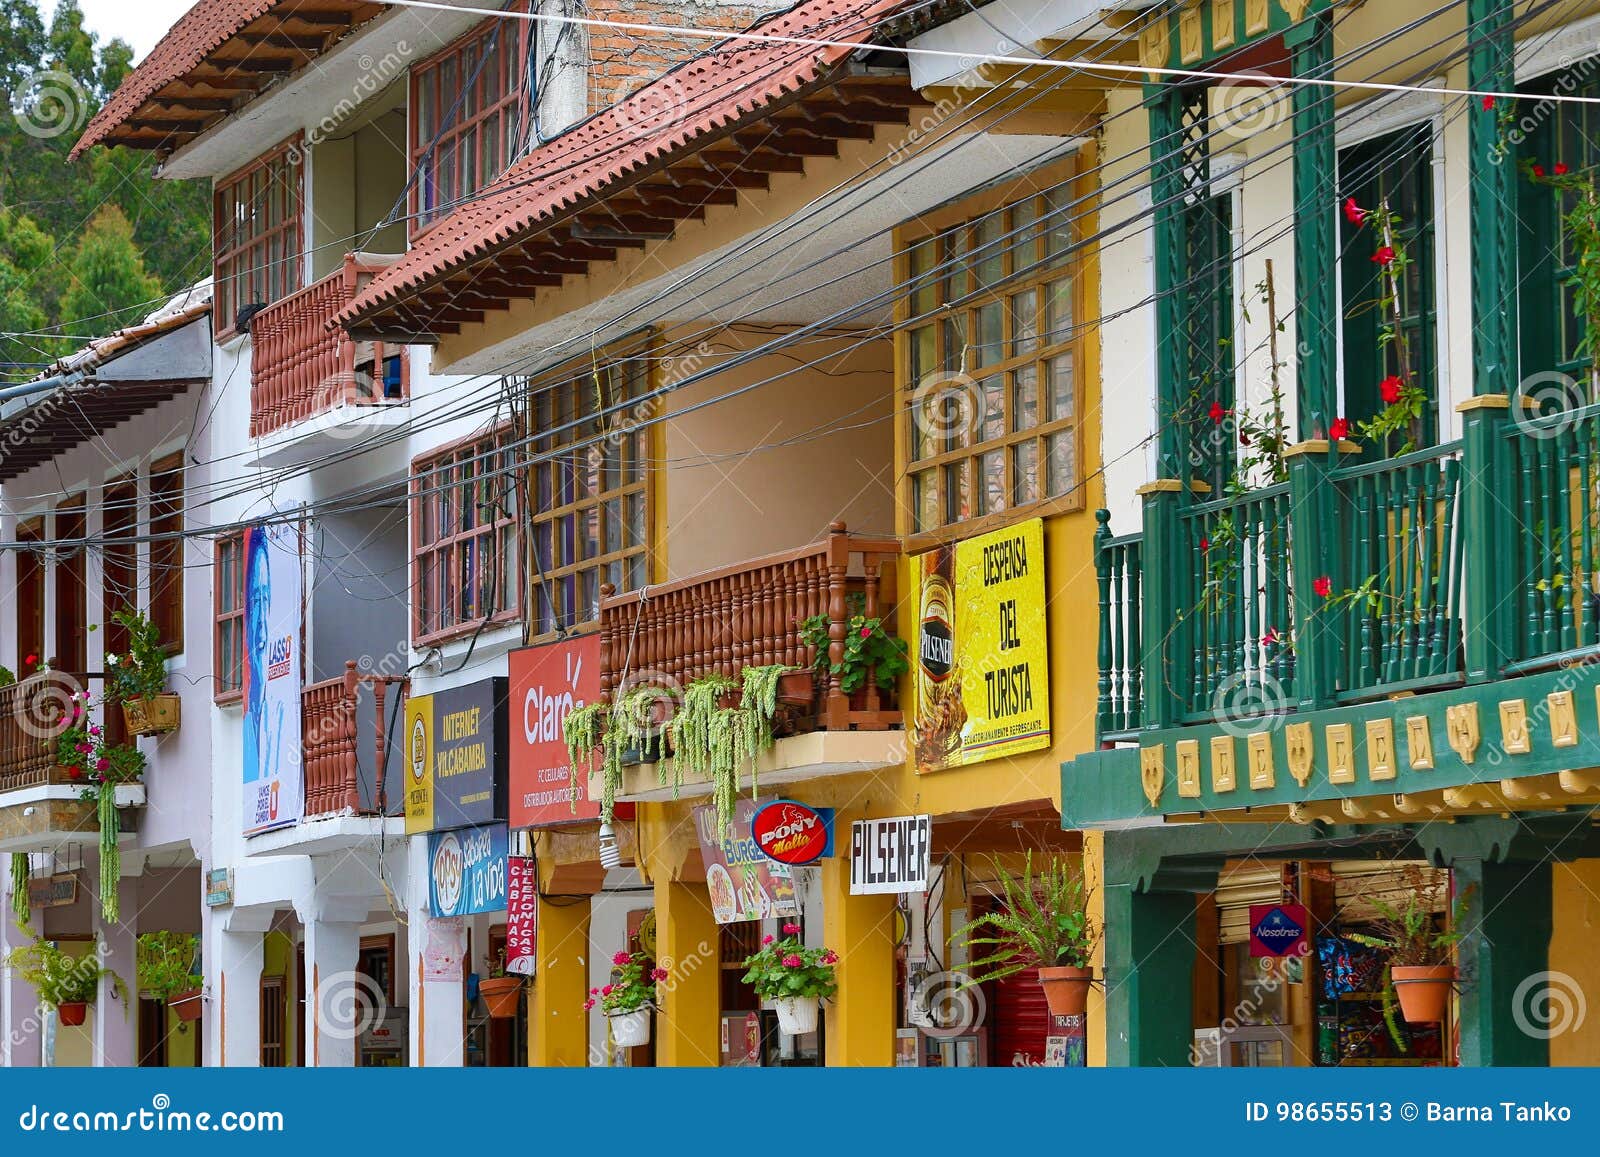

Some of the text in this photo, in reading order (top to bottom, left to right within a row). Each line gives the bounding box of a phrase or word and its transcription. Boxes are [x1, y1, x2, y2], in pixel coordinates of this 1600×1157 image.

[983, 536, 1028, 587] DESPENSA
[999, 599, 1021, 651] DEL
[524, 685, 575, 745] Claro
[984, 661, 1033, 720] TURISTA
[437, 743, 486, 779] VILCABAMBA
[761, 814, 819, 845] PONY
[771, 833, 811, 857] Malta
[852, 818, 928, 885] PILSENER
[508, 865, 521, 948] CABINAS
[519, 859, 535, 955] TELEFONICAS
[1256, 926, 1300, 937] Nosotras
[1055, 1015, 1079, 1027] TARJETAS
